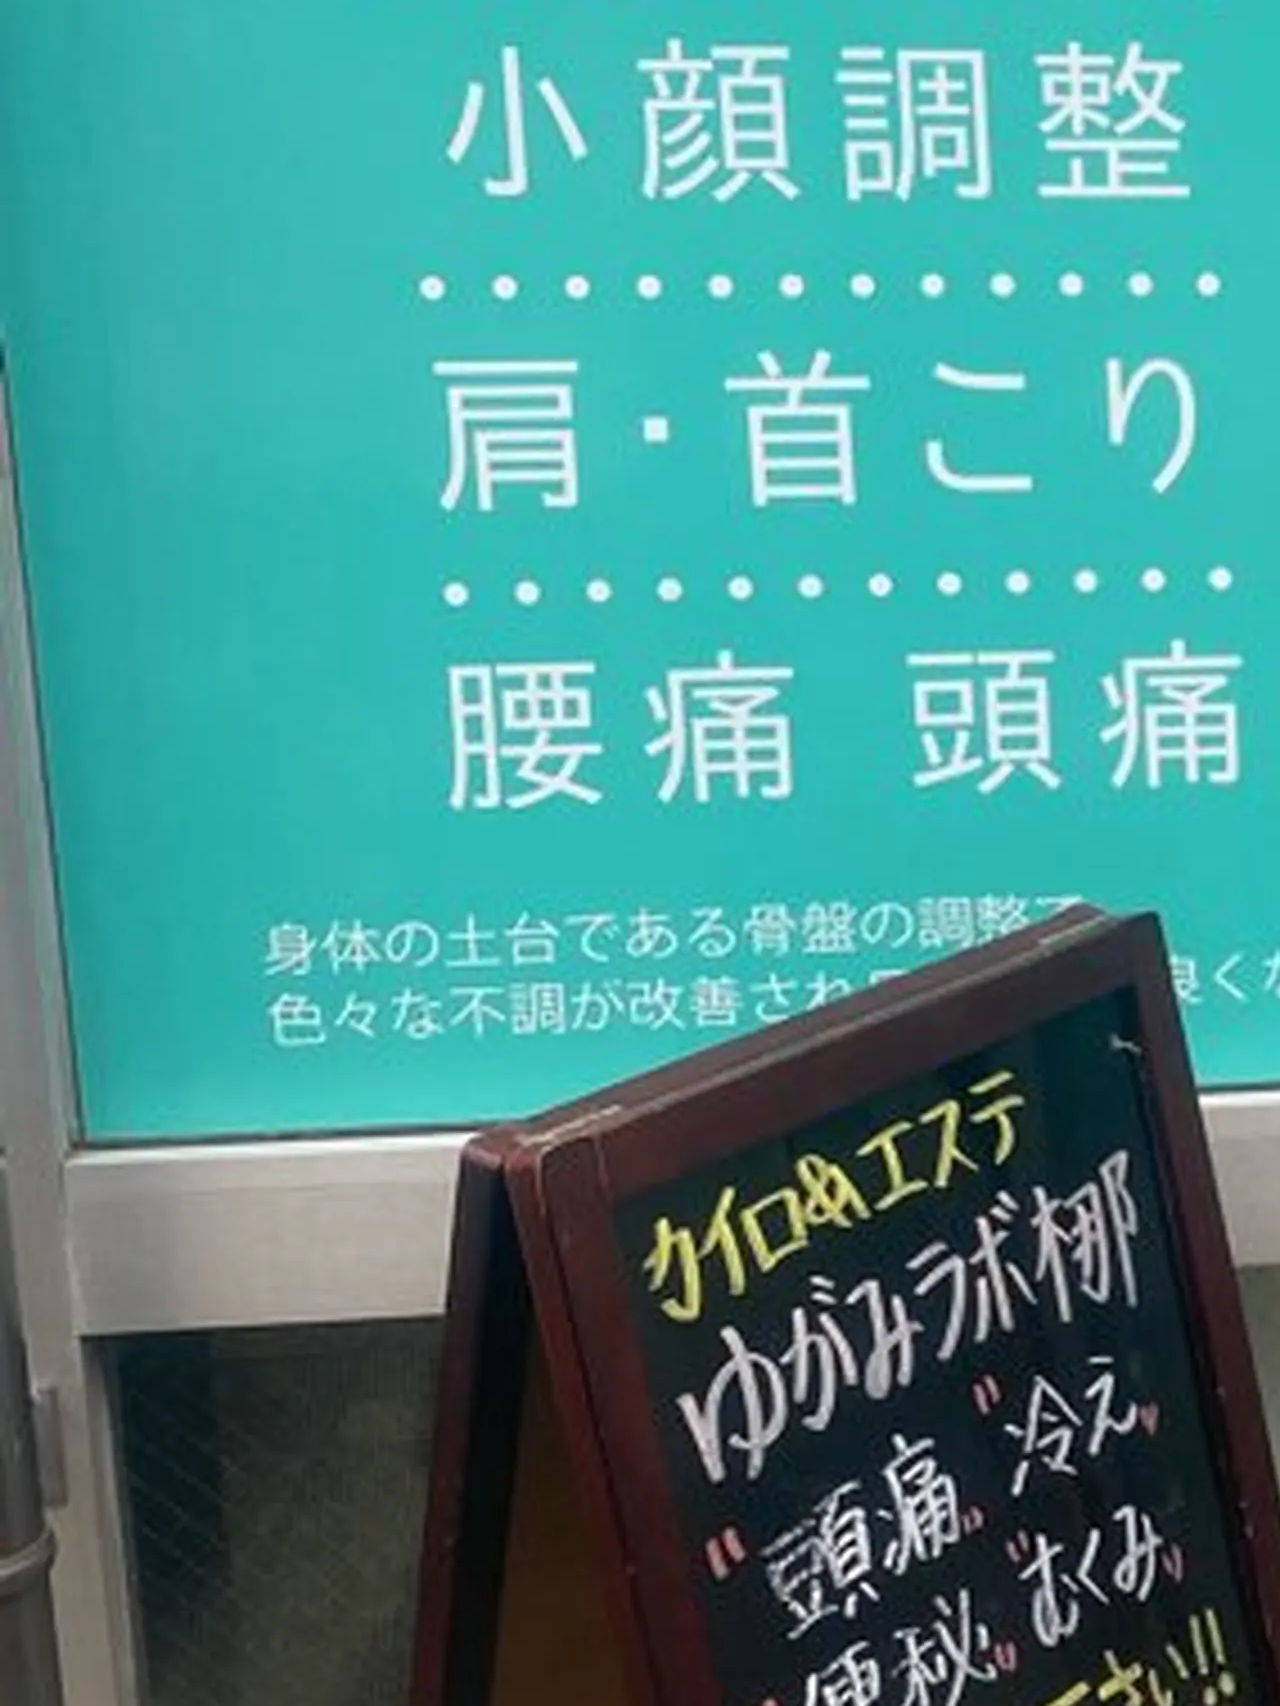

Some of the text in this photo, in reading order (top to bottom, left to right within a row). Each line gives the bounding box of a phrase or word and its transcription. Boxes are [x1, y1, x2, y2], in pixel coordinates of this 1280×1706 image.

[446, 37, 1192, 203] 小顔調整
[432, 349, 1198, 512] 肩・首こり
[447, 638, 1243, 811] 腰痛 頭痛
[268, 969, 908, 1048] 色々な不調が改善され
